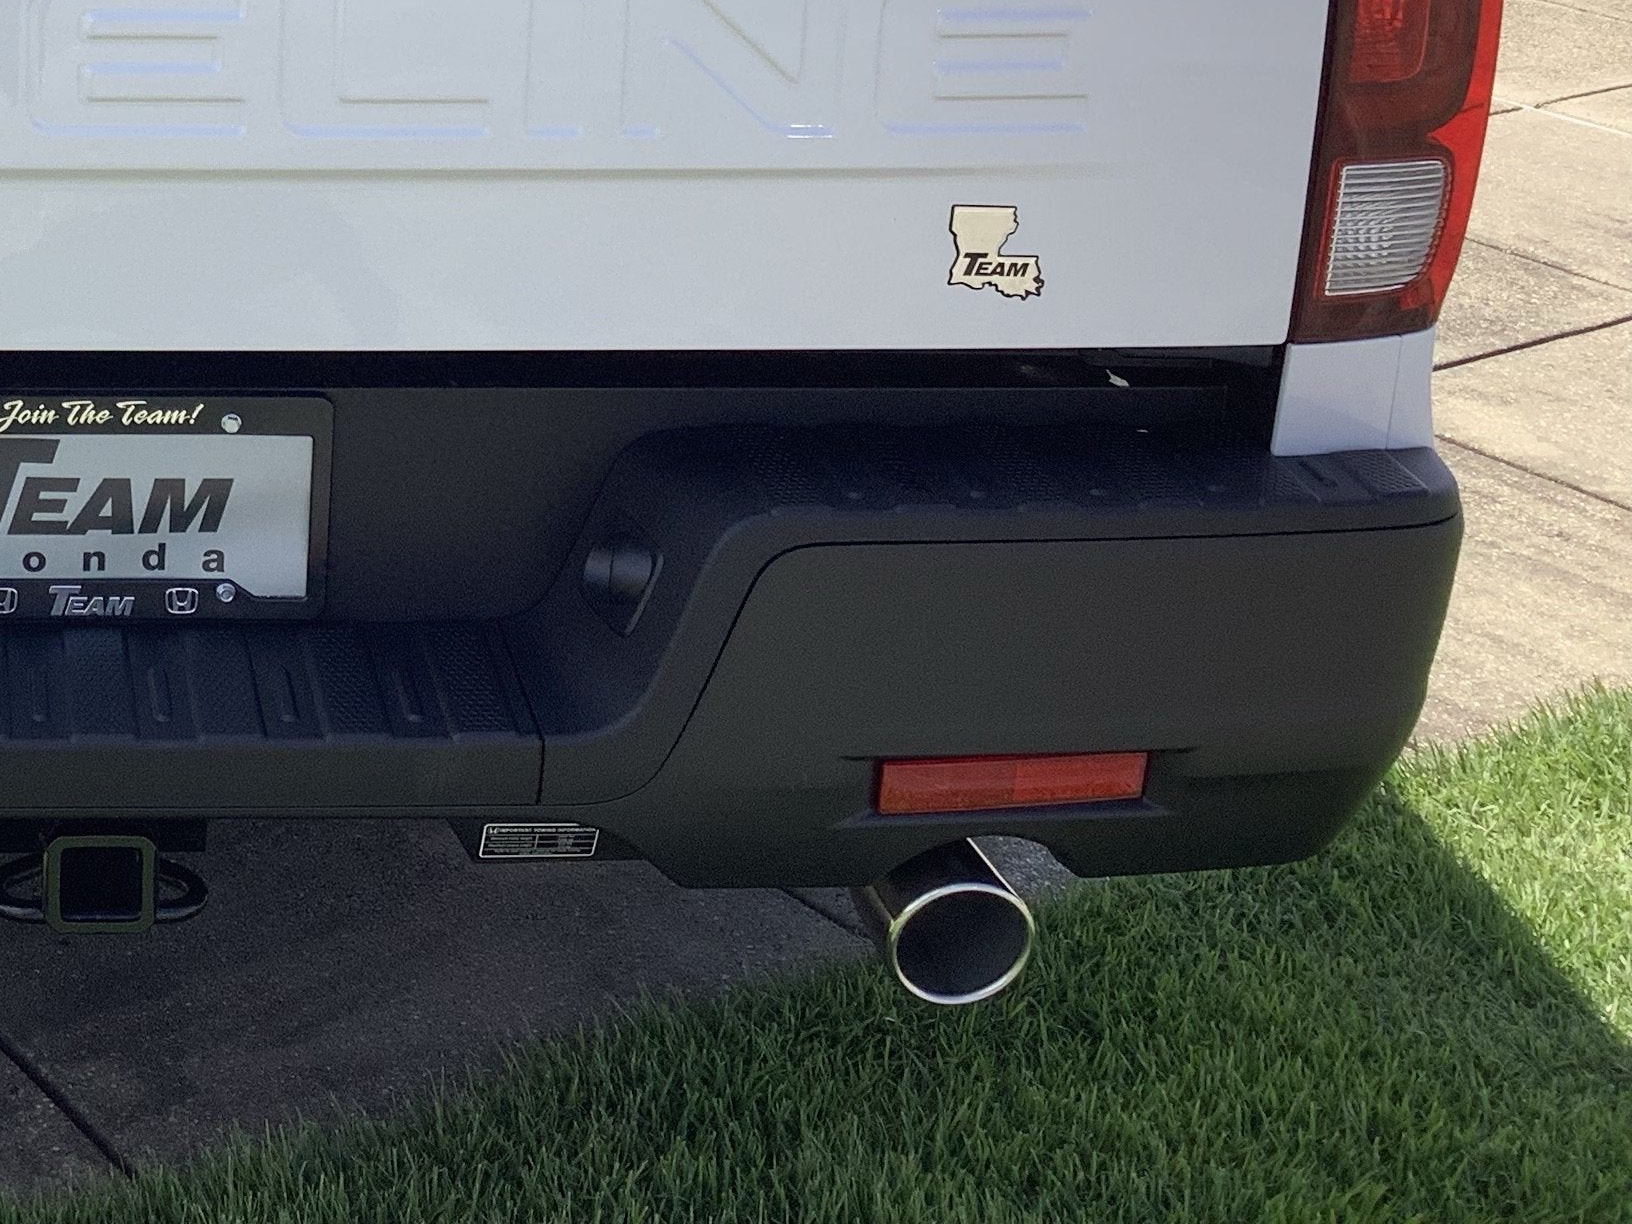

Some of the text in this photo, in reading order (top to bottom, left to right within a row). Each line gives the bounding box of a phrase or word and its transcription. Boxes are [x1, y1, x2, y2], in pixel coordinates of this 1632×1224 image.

[963, 253, 1029, 277] TEAM
[61, 401, 114, 426] The
[116, 401, 205, 426] Team!
[48, 585, 136, 617] TEAM
